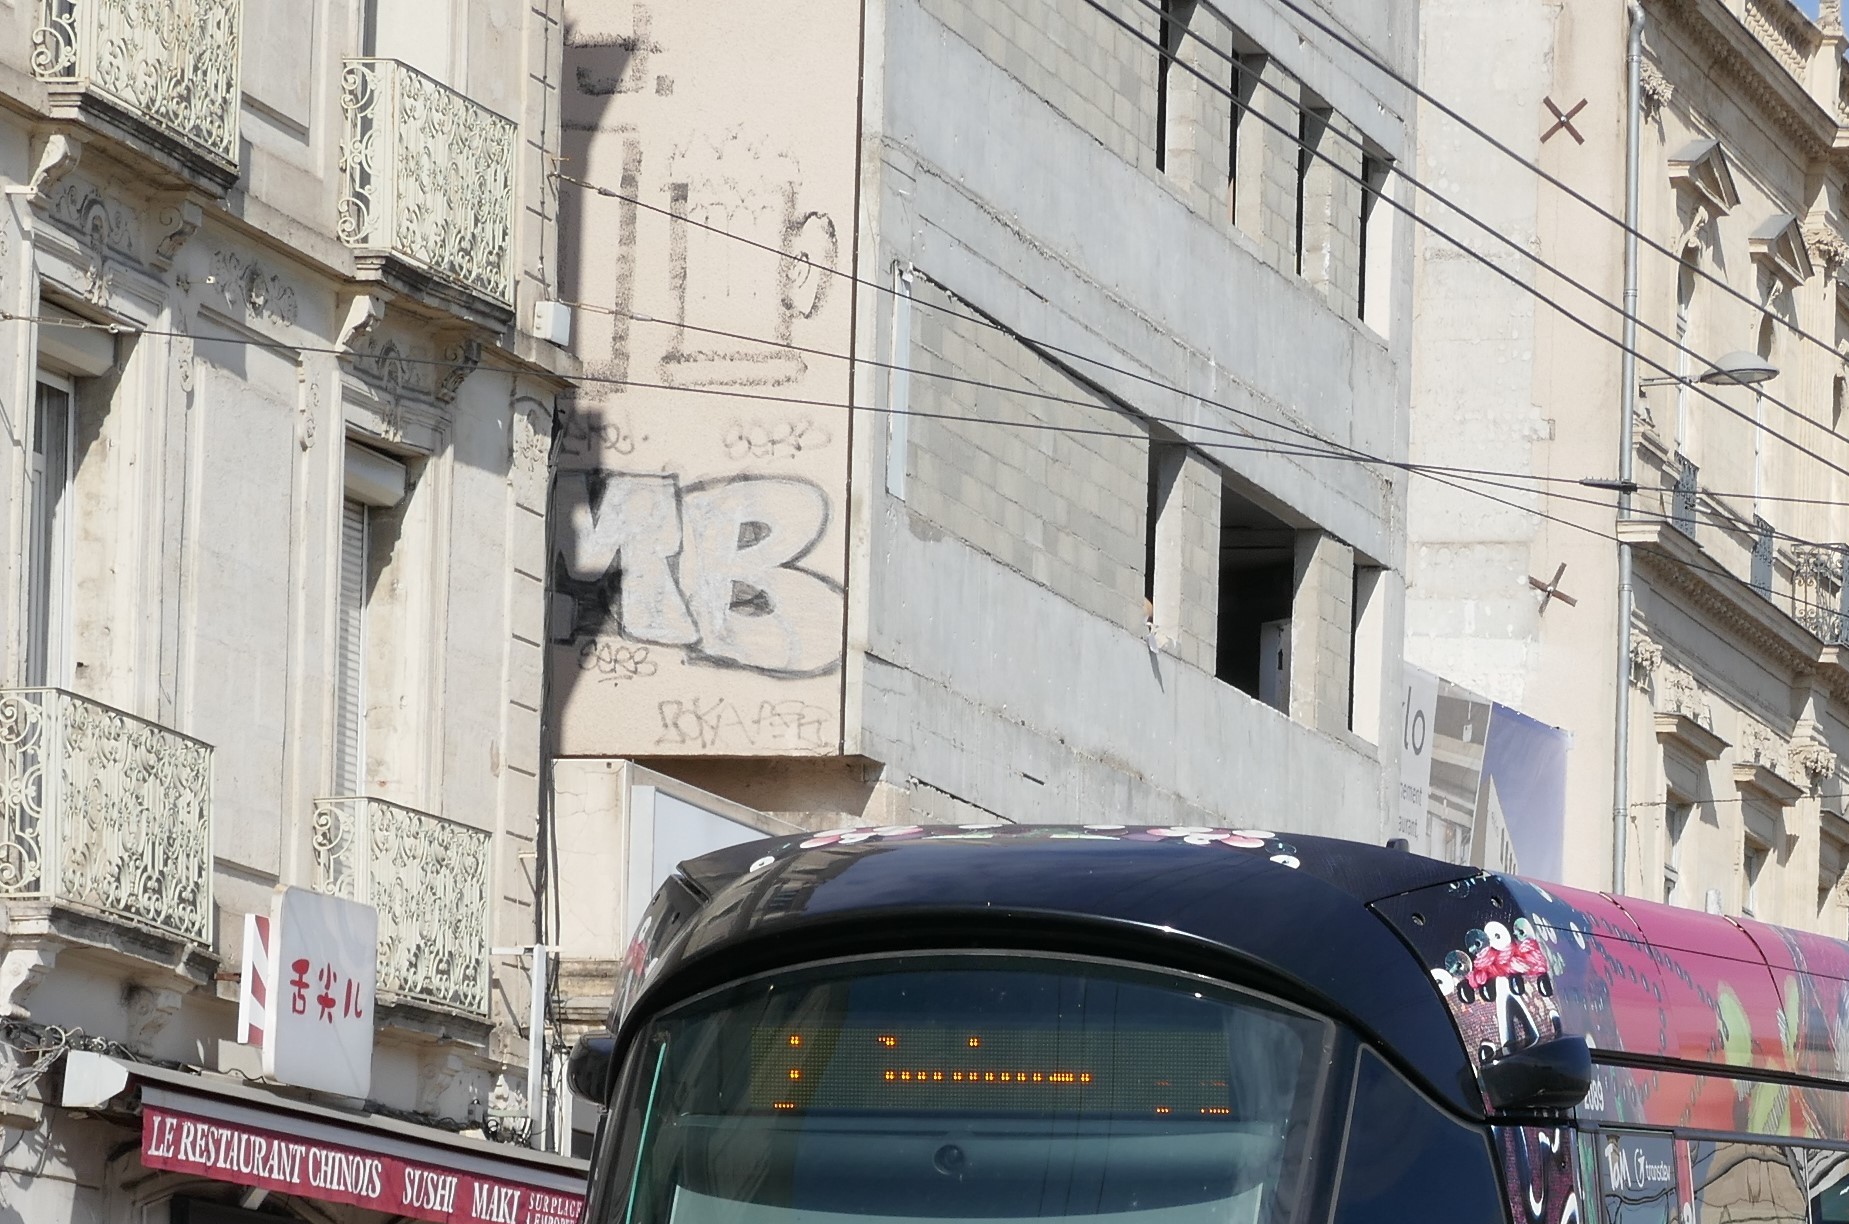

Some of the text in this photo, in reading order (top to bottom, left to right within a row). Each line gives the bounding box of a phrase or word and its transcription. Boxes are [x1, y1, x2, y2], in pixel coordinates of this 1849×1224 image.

[148, 1115, 521, 1224] LE RESTAURANT CHINOIS SUSHI MAKI
[528, 1192, 549, 1213] SUR
